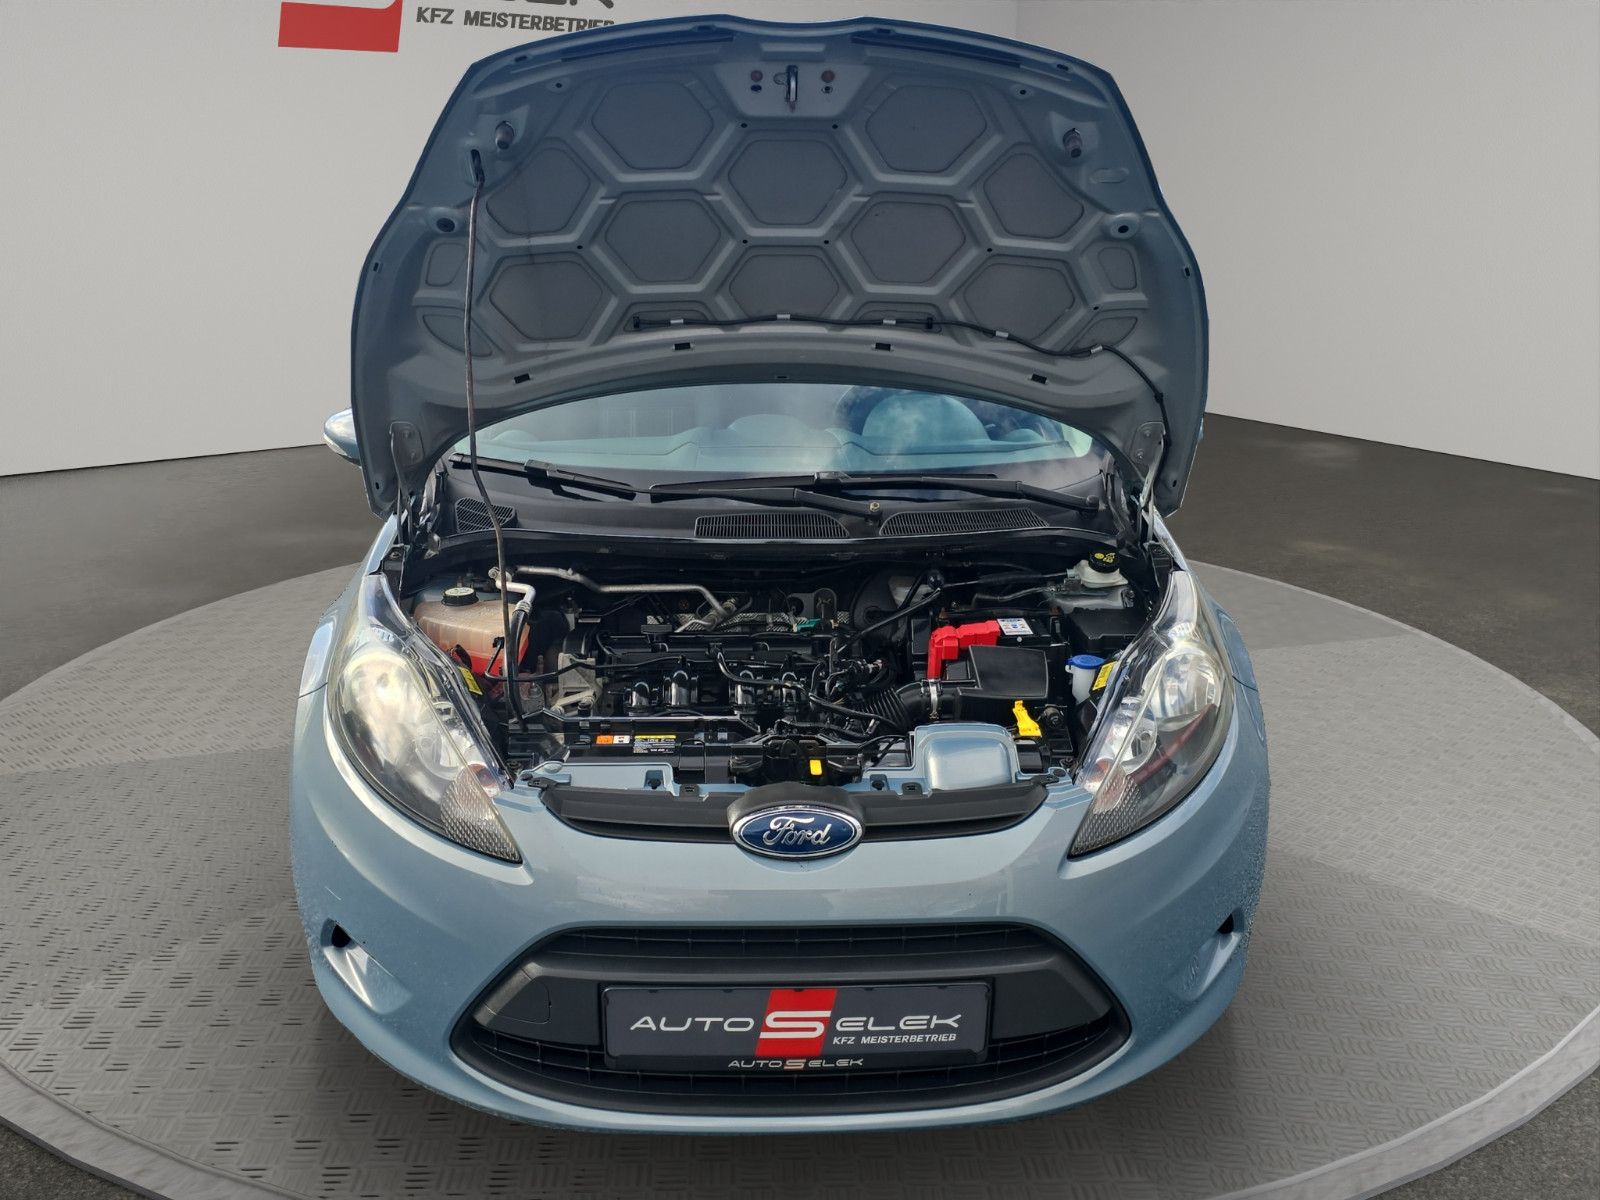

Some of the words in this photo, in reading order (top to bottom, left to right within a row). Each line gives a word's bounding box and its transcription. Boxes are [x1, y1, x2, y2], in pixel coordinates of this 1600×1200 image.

[416, 7, 454, 24] KFZ
[762, 816, 832, 846] Ford
[630, 1016, 755, 1032] AUTO
[833, 1036, 855, 1045] KFZ
[860, 1033, 957, 1044] MEISTERBETRIEB
[728, 1060, 783, 1068] AUTO
